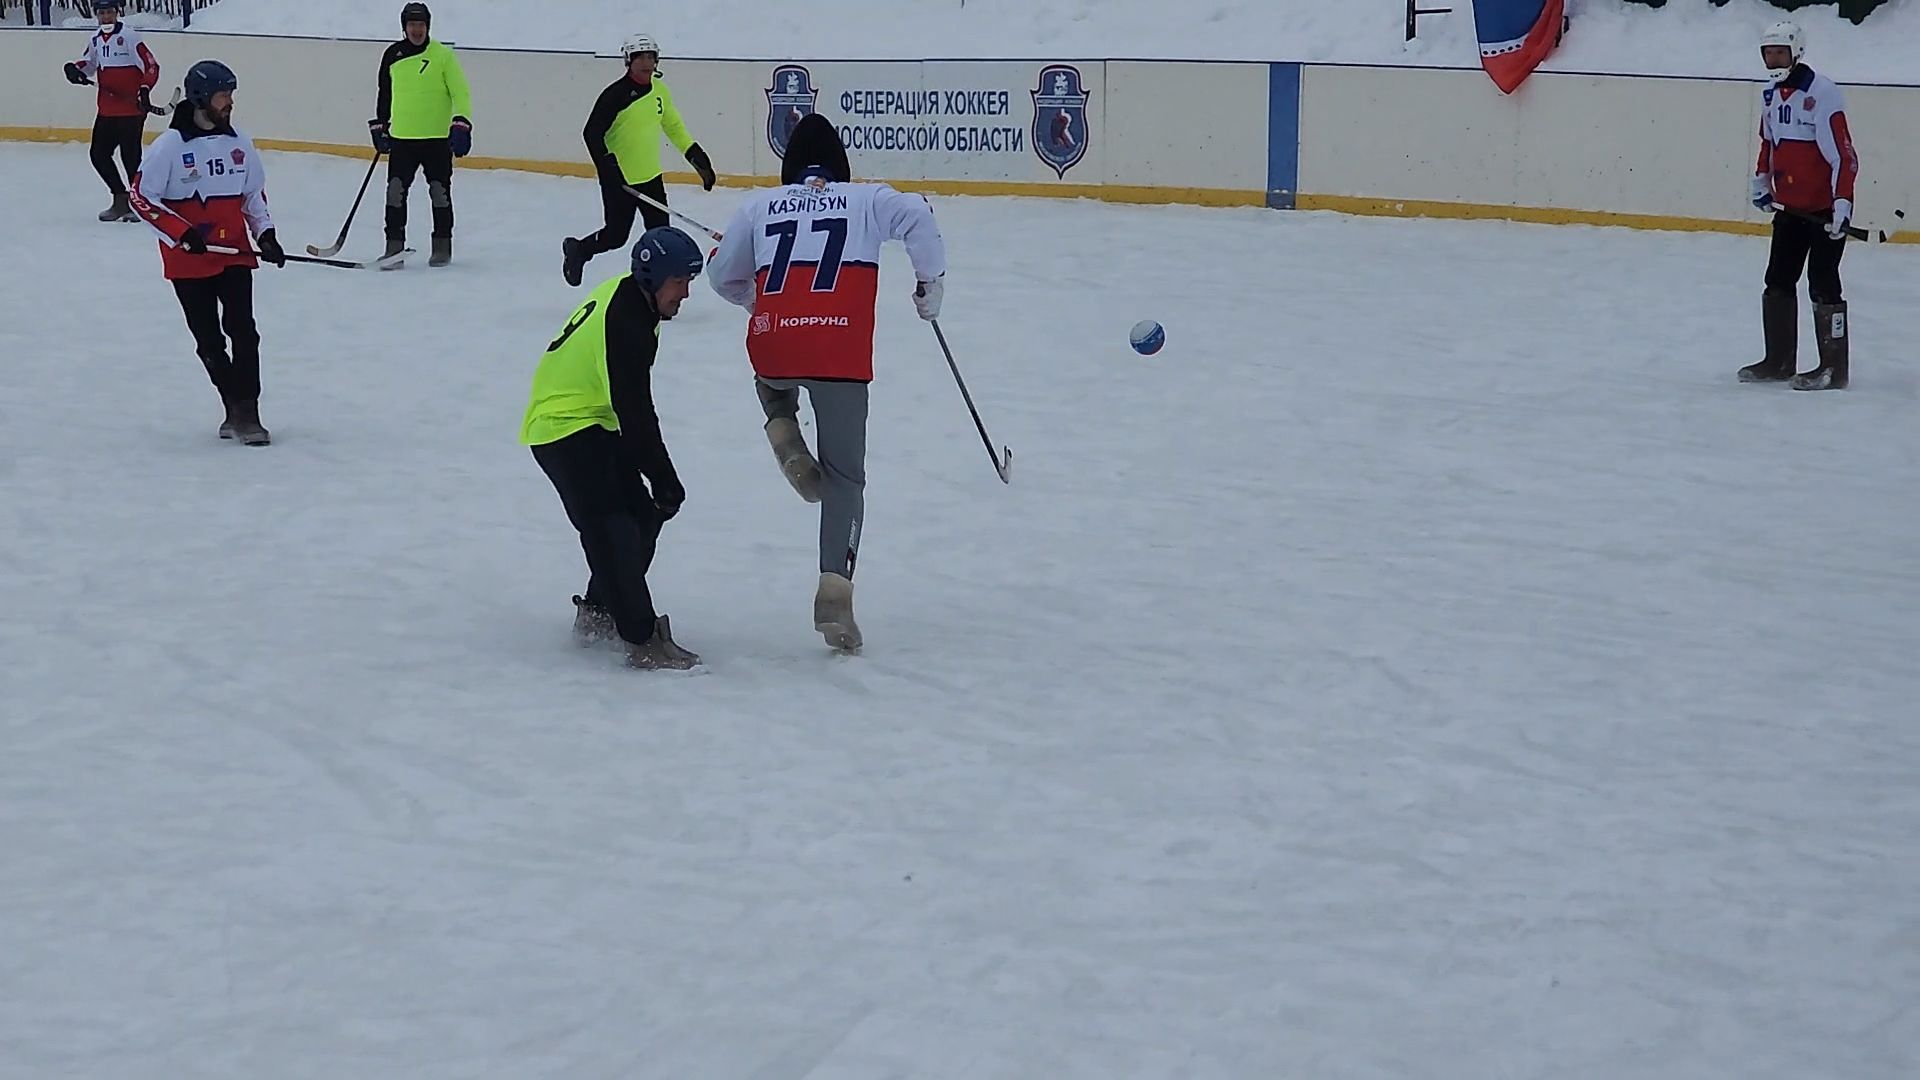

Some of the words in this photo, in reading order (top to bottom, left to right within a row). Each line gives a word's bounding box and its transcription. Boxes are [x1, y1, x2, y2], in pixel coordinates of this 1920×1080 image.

[102, 45, 110, 57] 11
[419, 59, 430, 74] 7
[656, 96, 663, 115] 3
[840, 90, 940, 120] ФЕДЕРАЦИЯ
[944, 90, 1009, 116] ХОККЕЯ
[1778, 104, 1792, 125] 10
[944, 126, 1024, 153] ОБЛАСТИ
[206, 158, 225, 177] 15
[768, 195, 848, 216] KASHITSYN
[763, 217, 848, 295] 77
[779, 315, 849, 328] КОРРУНД
